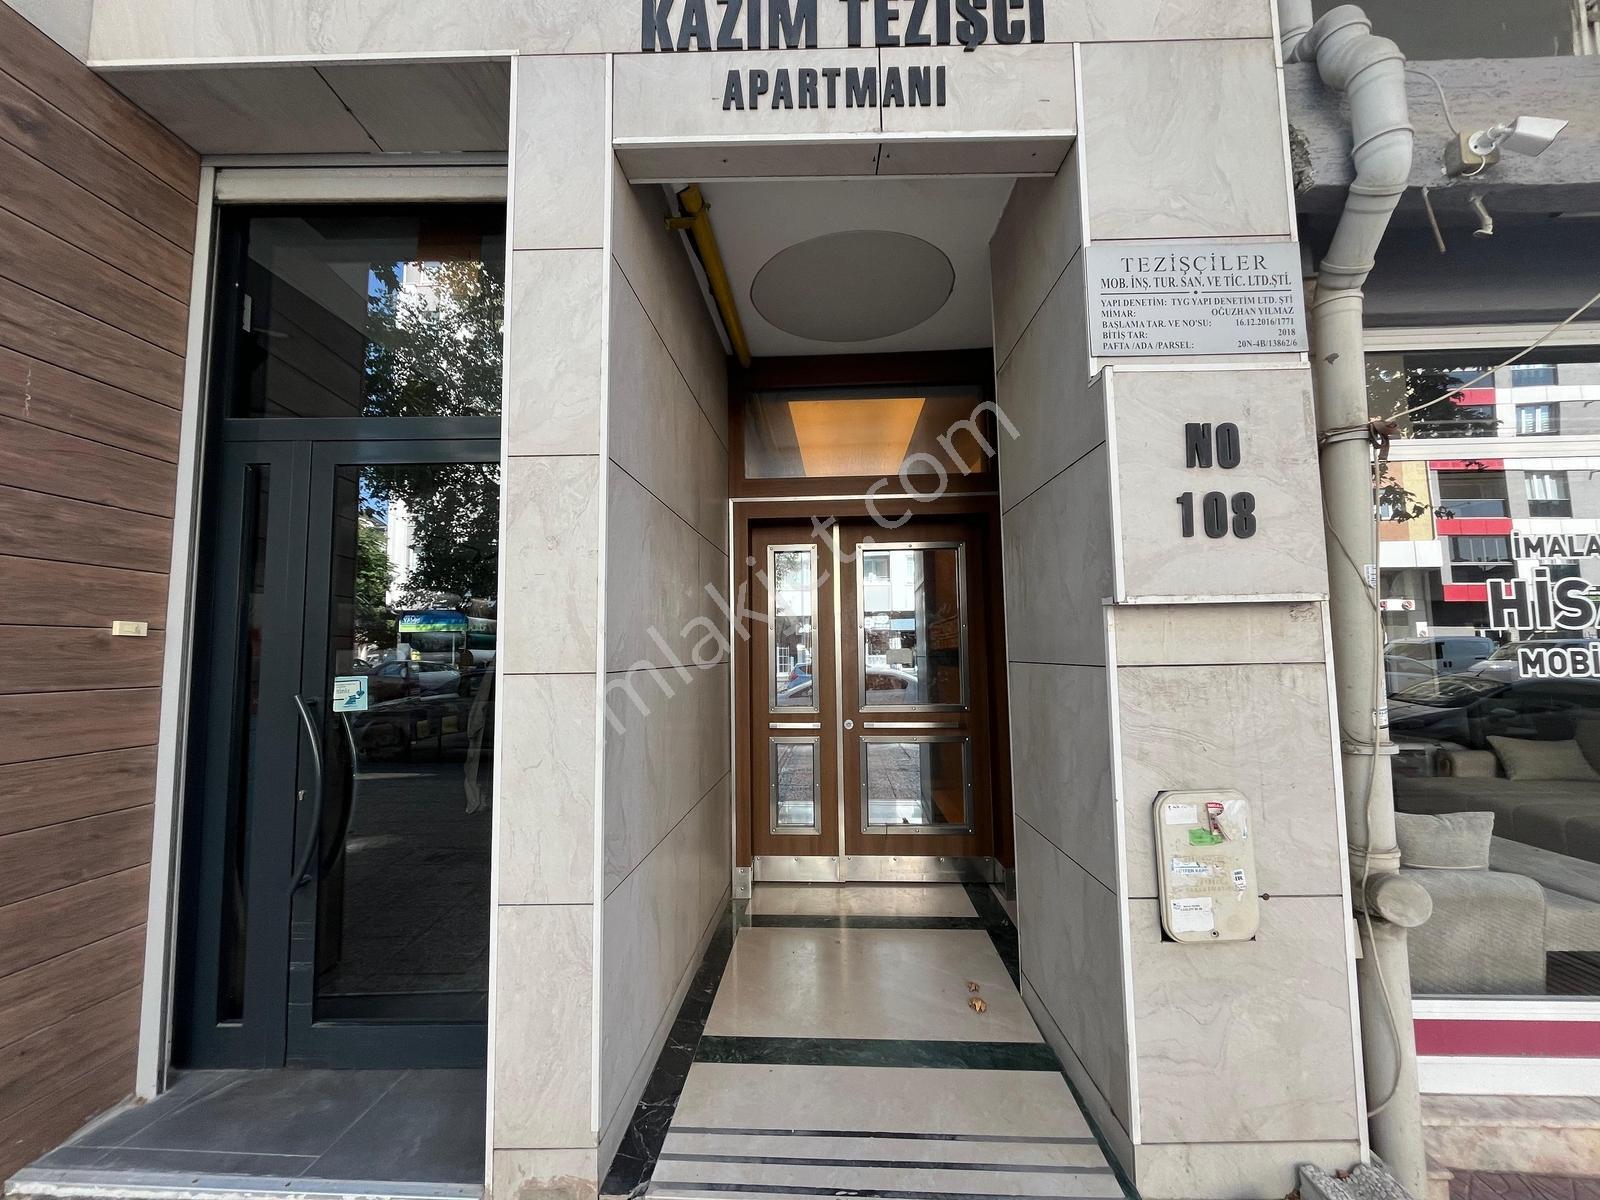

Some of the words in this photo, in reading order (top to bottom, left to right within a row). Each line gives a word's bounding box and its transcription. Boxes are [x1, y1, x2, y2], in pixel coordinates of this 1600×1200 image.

[641, 0, 818, 52] KAZIM
[722, 65, 947, 111] APARTMANI
[1120, 252, 1268, 275] TEZİŞÇİLER
[1101, 277, 1128, 289] MOB.
[1131, 274, 1151, 291] İNŞ.
[1153, 276, 1178, 288] TUR.
[1180, 275, 1205, 288] SAN.
[1207, 275, 1221, 287] VE
[1223, 273, 1246, 287] TİC.
[1101, 298, 1121, 307] YAPI
[1123, 297, 1167, 307] DENETİM:
[1170, 297, 1190, 306] TYG
[1191, 297, 1212, 306] YAPI
[1214, 295, 1255, 305] DENETİM
[1257, 296, 1277, 304] LTD.
[1101, 308, 1136, 318] MİMAR:
[1211, 306, 1256, 316] OĞUZHAN
[1258, 306, 1294, 316] YILMAZ
[1102, 320, 1145, 330] BAŞLAMA
[1168, 319, 1181, 328] VE
[1102, 329, 1126, 341] BİTİŞ
[1127, 330, 1148, 339] TAR:
[1278, 328, 1296, 336] 2018
[1103, 341, 1130, 350] PAFTA
[1185, 422, 1241, 469] NO
[1176, 491, 1257, 539] 108
[1486, 566, 1600, 631] HİS
